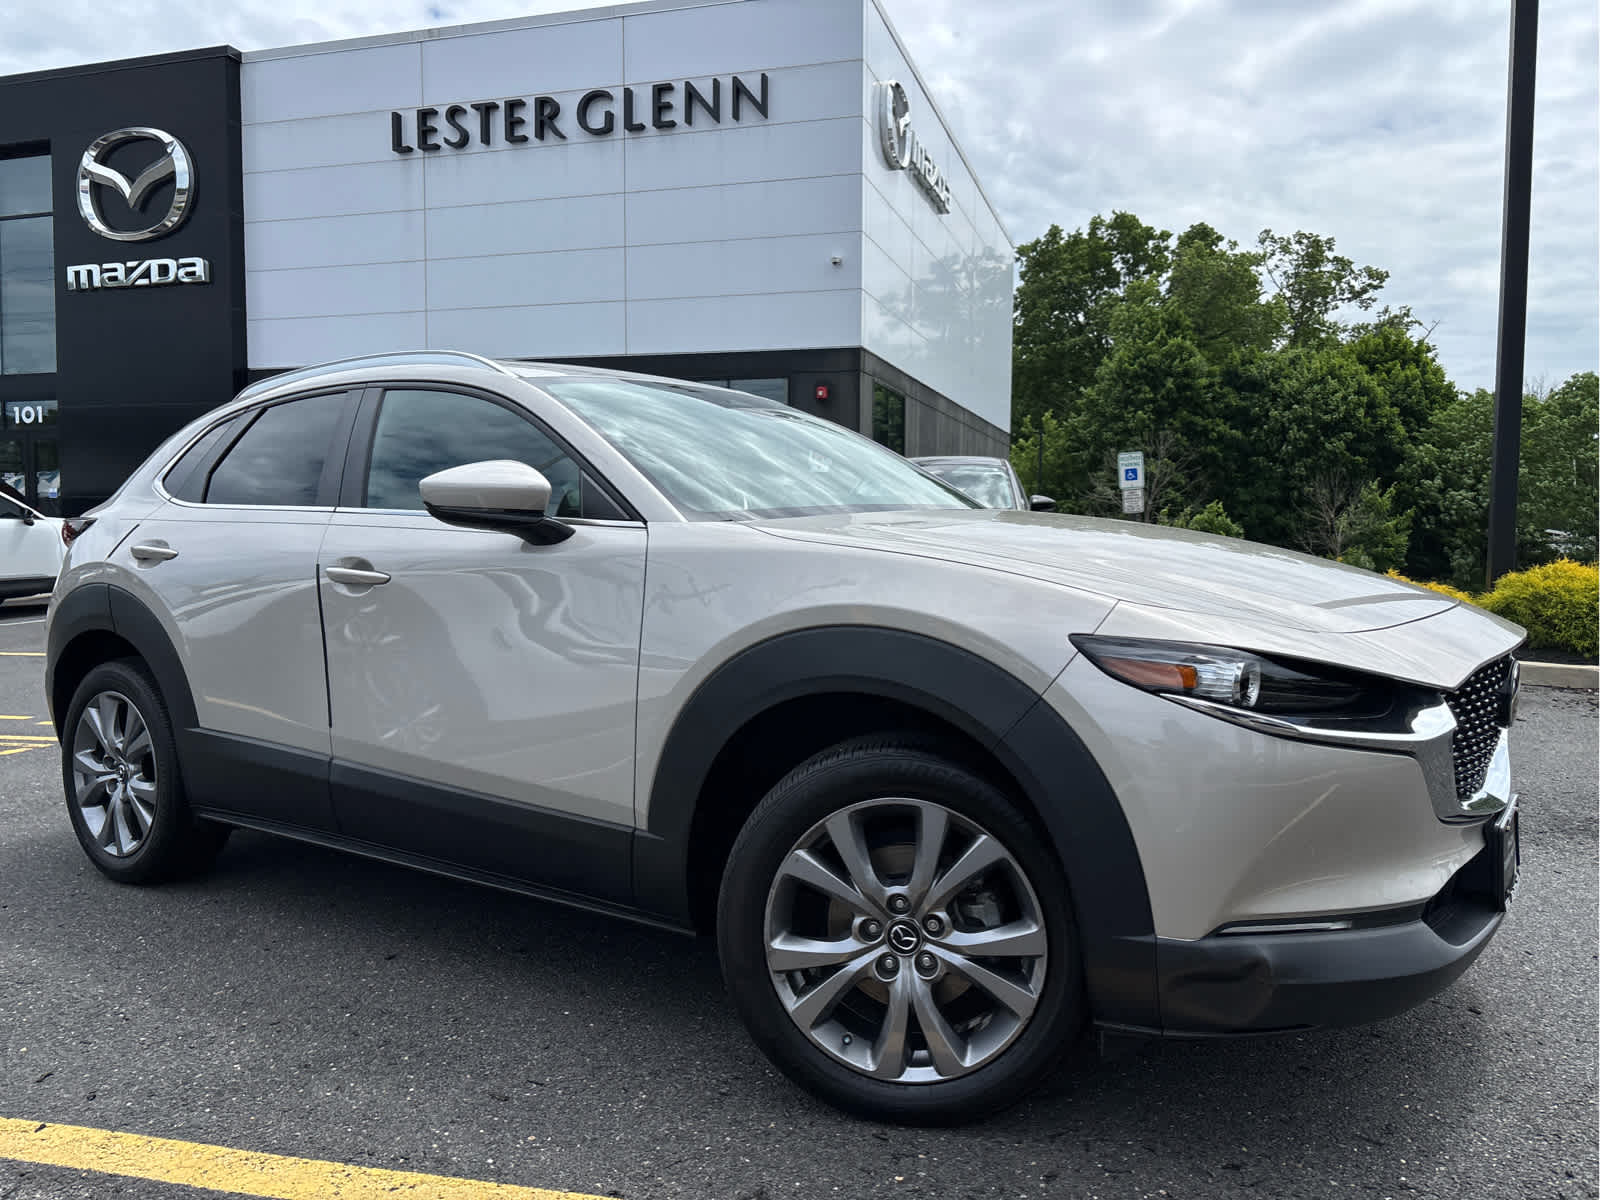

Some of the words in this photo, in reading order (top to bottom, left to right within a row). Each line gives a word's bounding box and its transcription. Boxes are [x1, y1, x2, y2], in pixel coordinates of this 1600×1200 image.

[391, 96, 567, 154] LESTER
[576, 72, 769, 136] GLENN
[13, 405, 43, 424] 101
